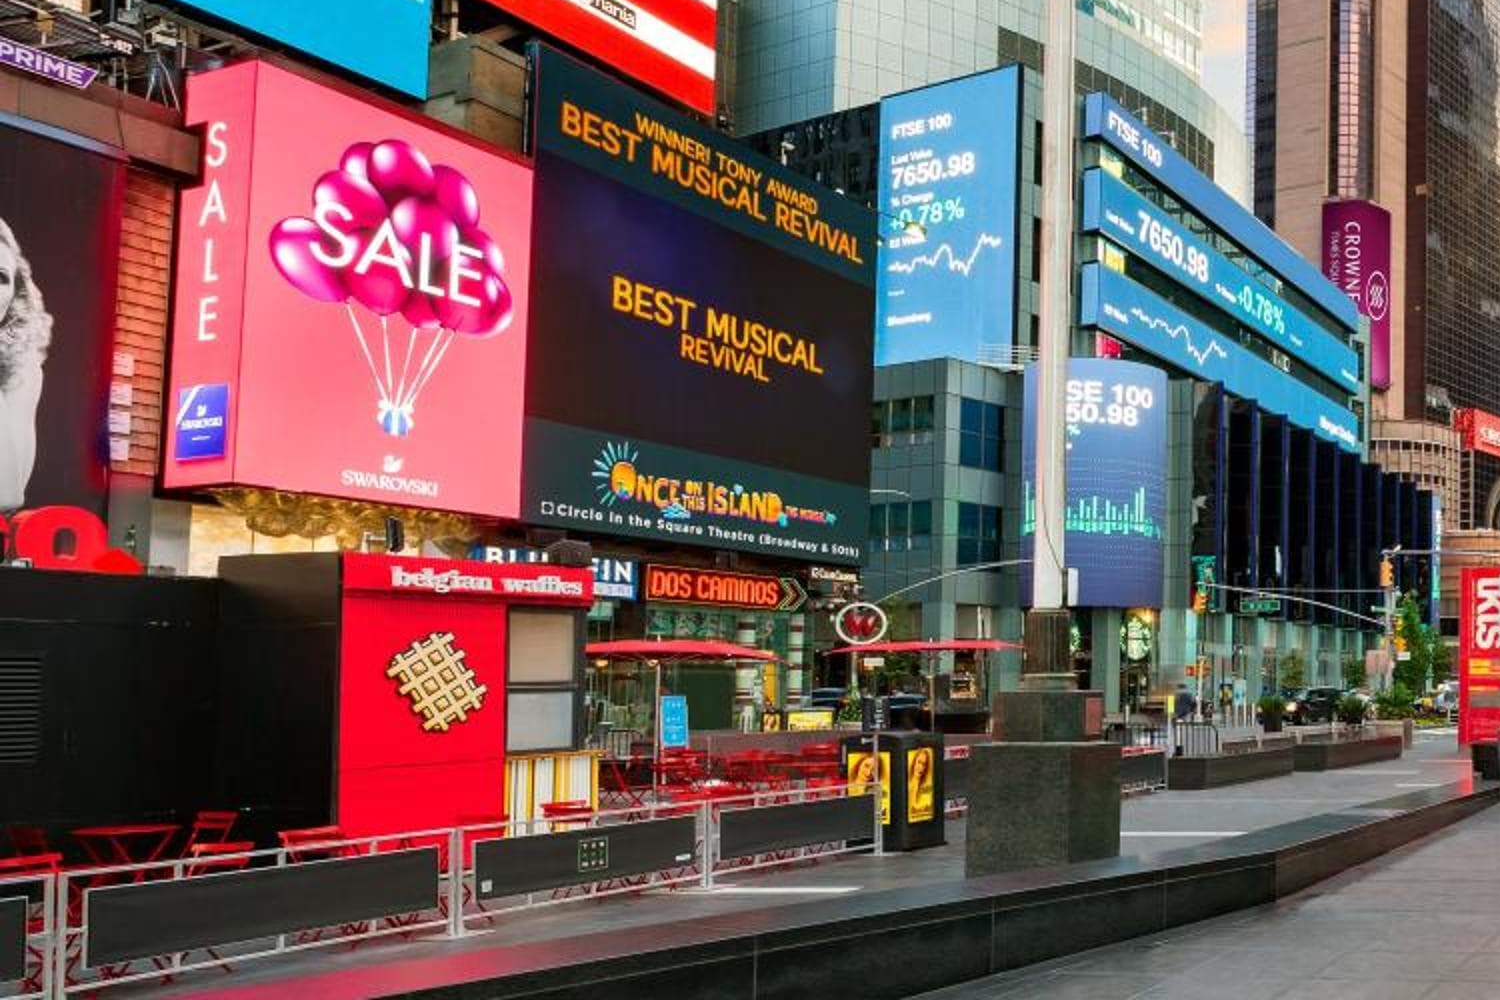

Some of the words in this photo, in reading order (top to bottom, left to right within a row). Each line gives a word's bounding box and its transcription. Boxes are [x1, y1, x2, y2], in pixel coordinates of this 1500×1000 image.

[0, 40, 83, 85] PRIME
[891, 119, 926, 140] FTSE
[928, 113, 953, 132] 100
[1107, 109, 1141, 151] FTSE
[1141, 138, 1163, 168] 100
[560, 100, 643, 164] BEST
[651, 143, 768, 223] MUSICAL
[774, 202, 864, 265] REVIVAL
[715, 149, 763, 189] TONY
[765, 178, 818, 216] AWARD
[890, 151, 976, 190] 7650.98
[198, 121, 229, 342] SALE
[309, 200, 485, 308] SALE
[1137, 209, 1210, 284] 7650.98
[611, 274, 697, 332] BEST
[706, 306, 825, 376] MUSICAL
[1238, 284, 1286, 335] +0.78%
[679, 332, 771, 383] REVIVAL
[1111, 383, 1154, 409] 100
[340, 469, 439, 499] SWAROVSKI
[706, 481, 785, 525] ISLAND
[556, 502, 604, 522] Circle
[628, 511, 653, 530] the
[656, 518, 704, 540] Square
[707, 524, 757, 543] Theatre
[651, 570, 691, 599] DOS
[695, 576, 780, 607] CAMINOS
